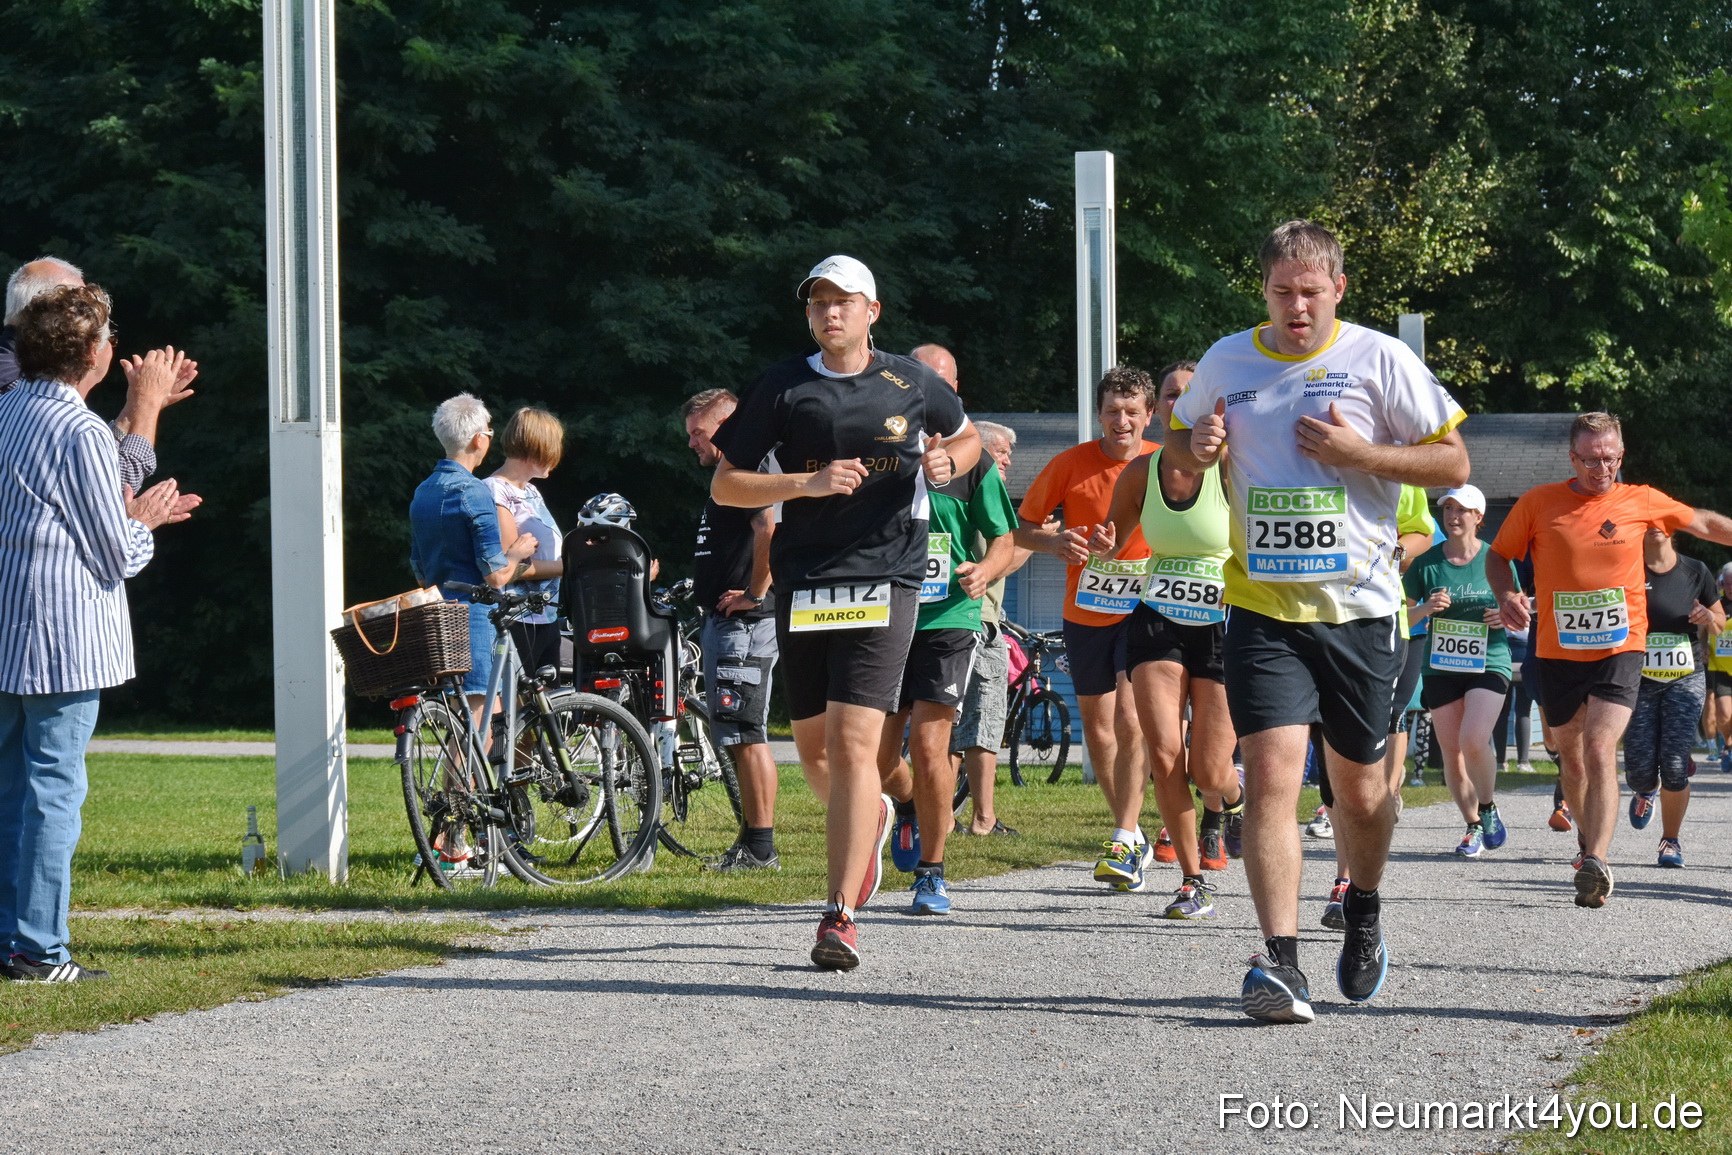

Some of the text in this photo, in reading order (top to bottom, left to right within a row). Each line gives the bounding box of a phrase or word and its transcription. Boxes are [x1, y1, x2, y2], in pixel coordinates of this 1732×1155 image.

[880, 370, 910, 389] 2XU
[1307, 368, 1327, 381] 20
[1305, 381, 1353, 389] Neumarkter
[1227, 390, 1257, 404] BOCK
[1303, 390, 1342, 398] Stadtlauf
[1252, 490, 1338, 512] BOCK
[1255, 520, 1336, 549] 2588
[1158, 559, 1222, 579] BOCK
[1256, 558, 1336, 571] MATTHIAS
[1087, 574, 1142, 595] 2474
[1155, 578, 1219, 605] 2658
[1094, 596, 1131, 609] FRANZ
[1559, 589, 1620, 608] BOCK
[814, 610, 866, 622] MARCO
[1158, 605, 1211, 620] BETTINA
[1563, 608, 1620, 630] 2475
[1436, 620, 1482, 636] BOCK
[1437, 636, 1480, 655] 2066
[1576, 633, 1613, 643] FRANZ
[1438, 656, 1474, 667] SANDRA
[1644, 651, 1688, 667] 1110
